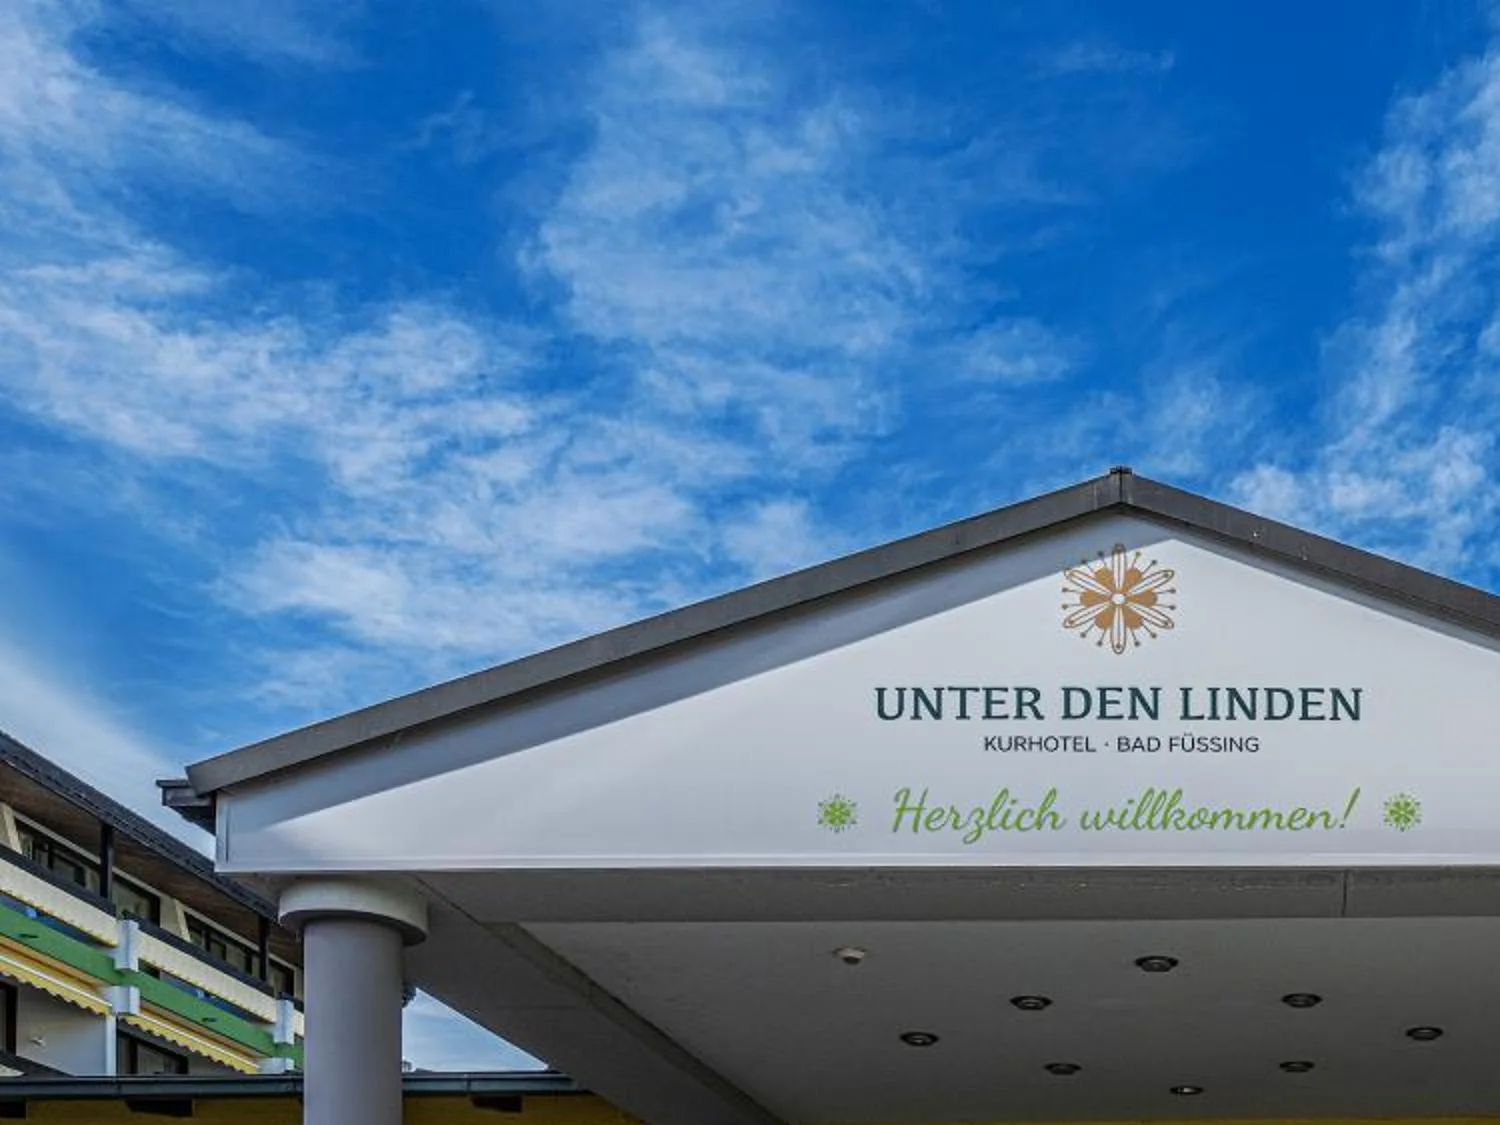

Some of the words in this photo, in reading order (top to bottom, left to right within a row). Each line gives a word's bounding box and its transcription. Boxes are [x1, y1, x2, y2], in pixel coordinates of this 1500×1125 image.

[874, 686, 1045, 721] UNTER
[1060, 686, 1162, 721] DEN
[1179, 687, 1363, 722] LINDEN
[983, 735, 1097, 753] KURHOTEL
[1117, 735, 1162, 753] BAD
[1168, 732, 1260, 753] FÜSSING
[892, 787, 1065, 844] Herzlich
[1079, 787, 1361, 832] willkommen!
